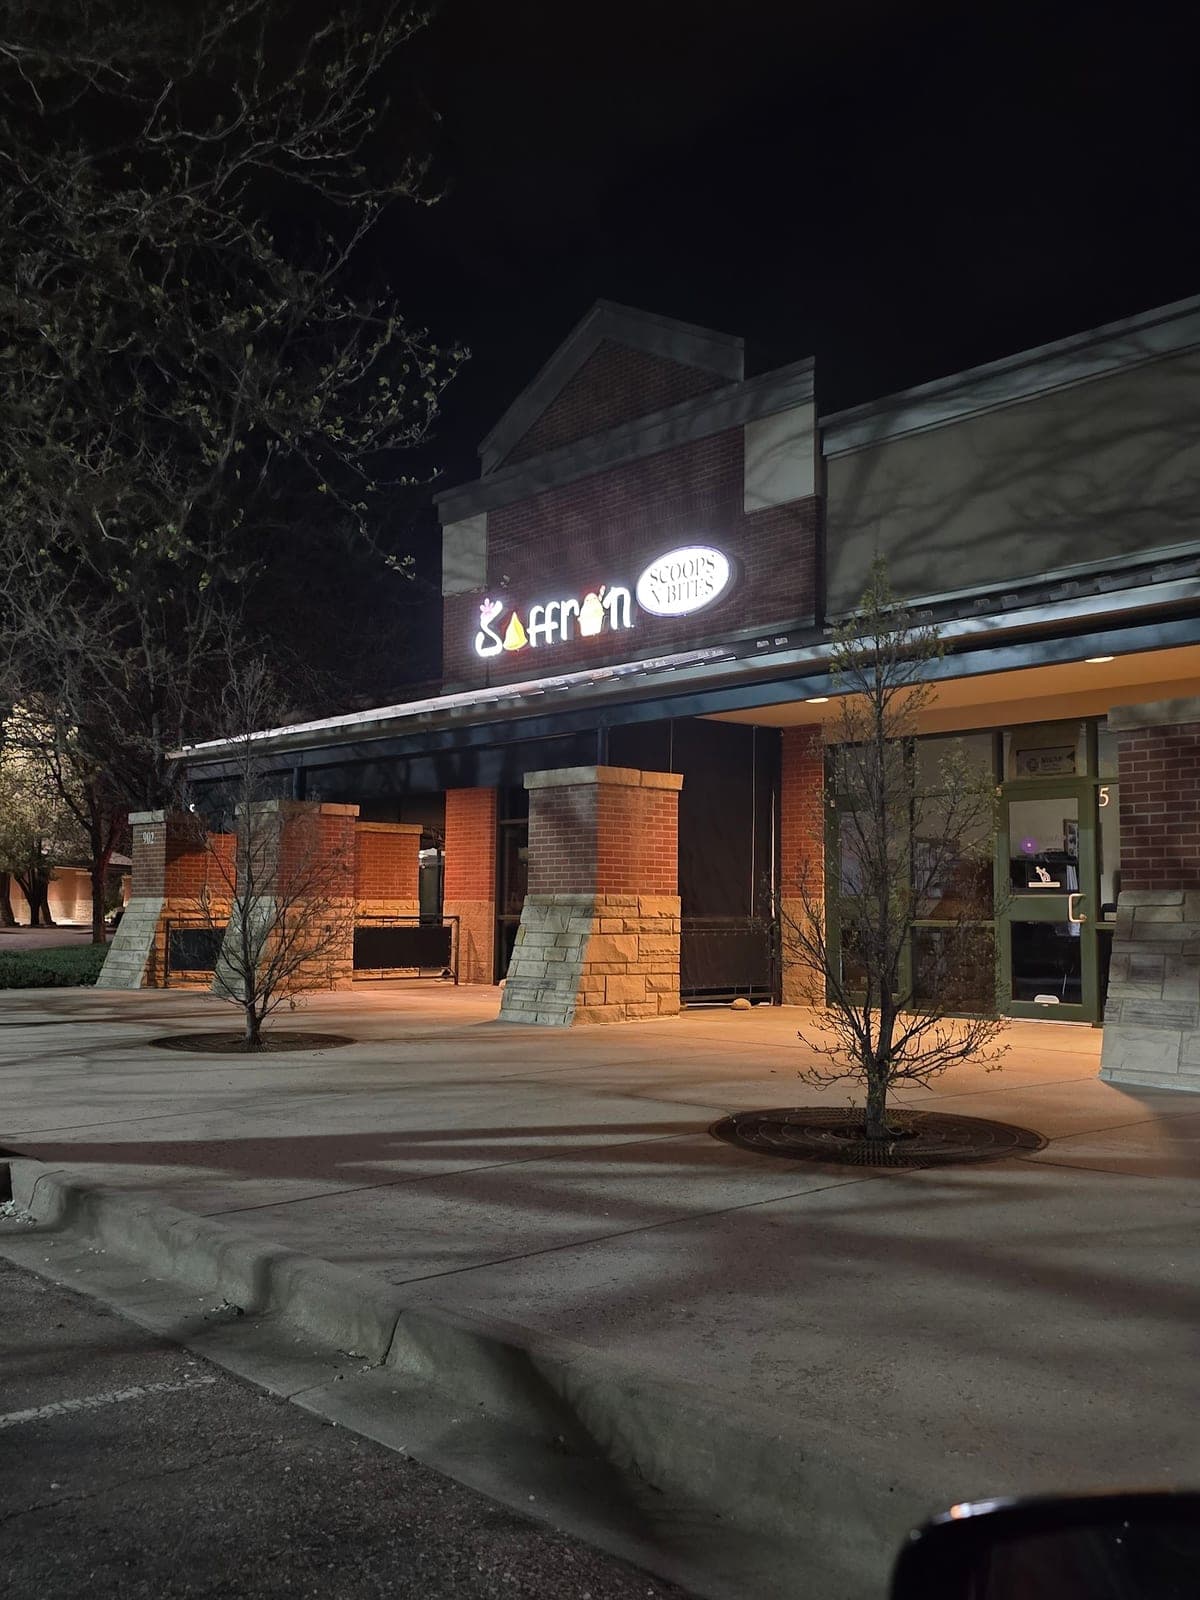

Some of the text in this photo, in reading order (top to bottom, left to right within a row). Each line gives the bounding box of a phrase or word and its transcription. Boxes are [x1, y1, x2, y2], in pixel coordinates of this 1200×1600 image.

[649, 554, 715, 587] SCOOPS
[667, 575, 714, 604] BITES
[1098, 787, 1109, 807] 5
